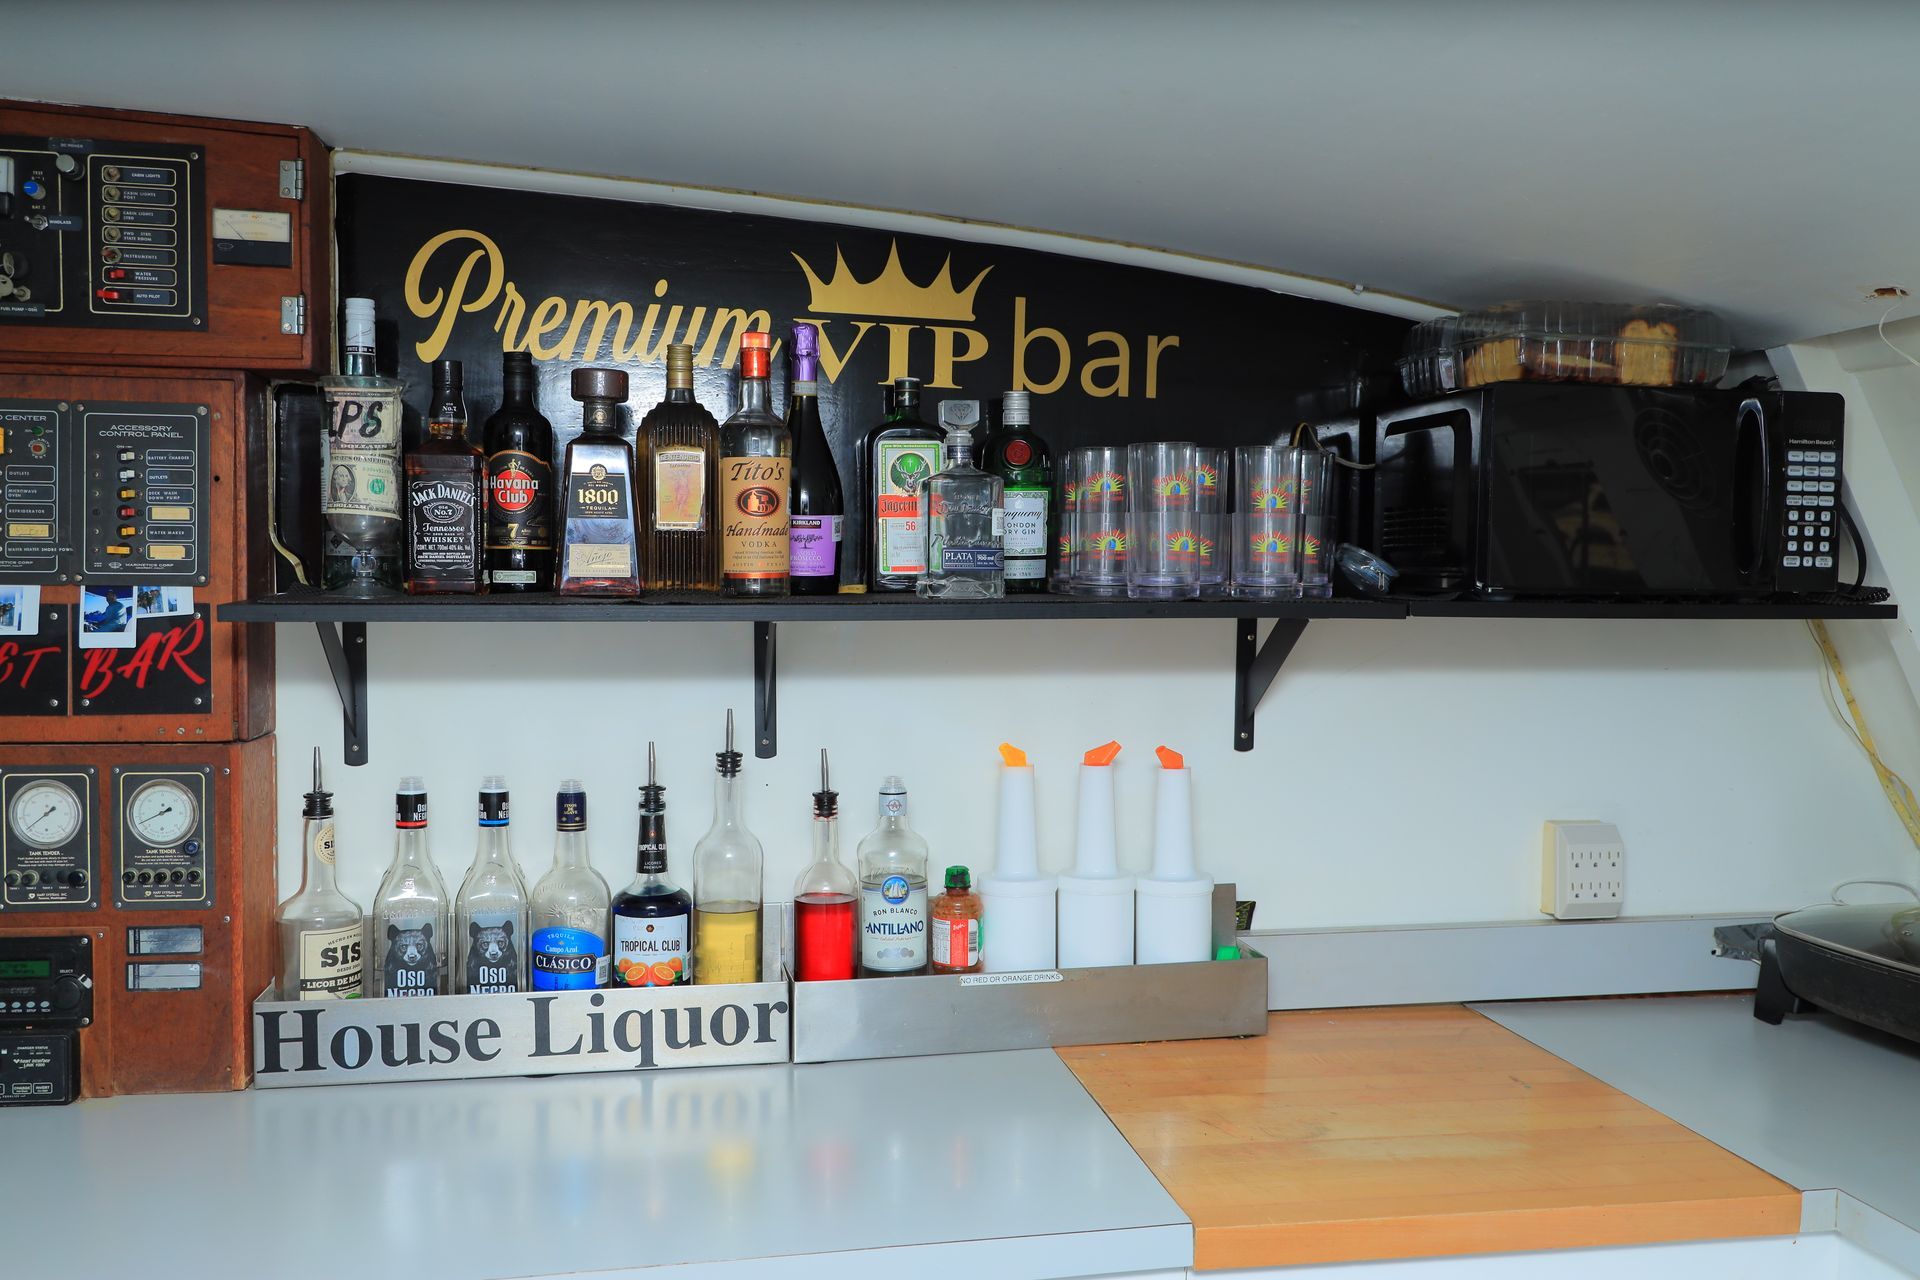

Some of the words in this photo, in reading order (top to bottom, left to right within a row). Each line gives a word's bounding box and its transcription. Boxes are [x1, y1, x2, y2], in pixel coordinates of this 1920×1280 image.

[404, 229, 782, 370] Premium
[793, 318, 989, 390] VIP
[1012, 296, 1180, 399] bar
[326, 400, 383, 440] IPS
[731, 460, 784, 482] Tito's
[490, 475, 539, 490] Havana
[412, 488, 437, 506] JACK
[437, 484, 477, 507] DANIEL'S
[498, 490, 528, 504] Club
[578, 488, 618, 505] 1800
[880, 498, 918, 513] Jägerm
[1004, 512, 1042, 520] nqueray
[422, 522, 465, 532] Tennessee
[507, 523, 520, 540] 7
[906, 521, 916, 531] 56
[0, 641, 62, 689] ET
[79, 618, 207, 700] BAR
[324, 840, 334, 850] SI
[872, 908, 888, 916] RON
[890, 908, 918, 916] BLANCO
[866, 920, 924, 935] ANTILLANO
[328, 936, 346, 946] HECHO
[547, 932, 575, 940] TEQUILA
[545, 944, 564, 954] Campo
[620, 940, 658, 952] TROPICAL
[662, 940, 681, 952] CLUB
[536, 954, 592, 970] CLÁSICO
[397, 969, 426, 988] OSO
[480, 966, 507, 984] OSO
[1002, 974, 1032, 982] ORANGE
[306, 981, 336, 989] LICOR
[336, 977, 348, 986] DE
[255, 1008, 502, 1075] House
[526, 993, 789, 1069] Liquor
